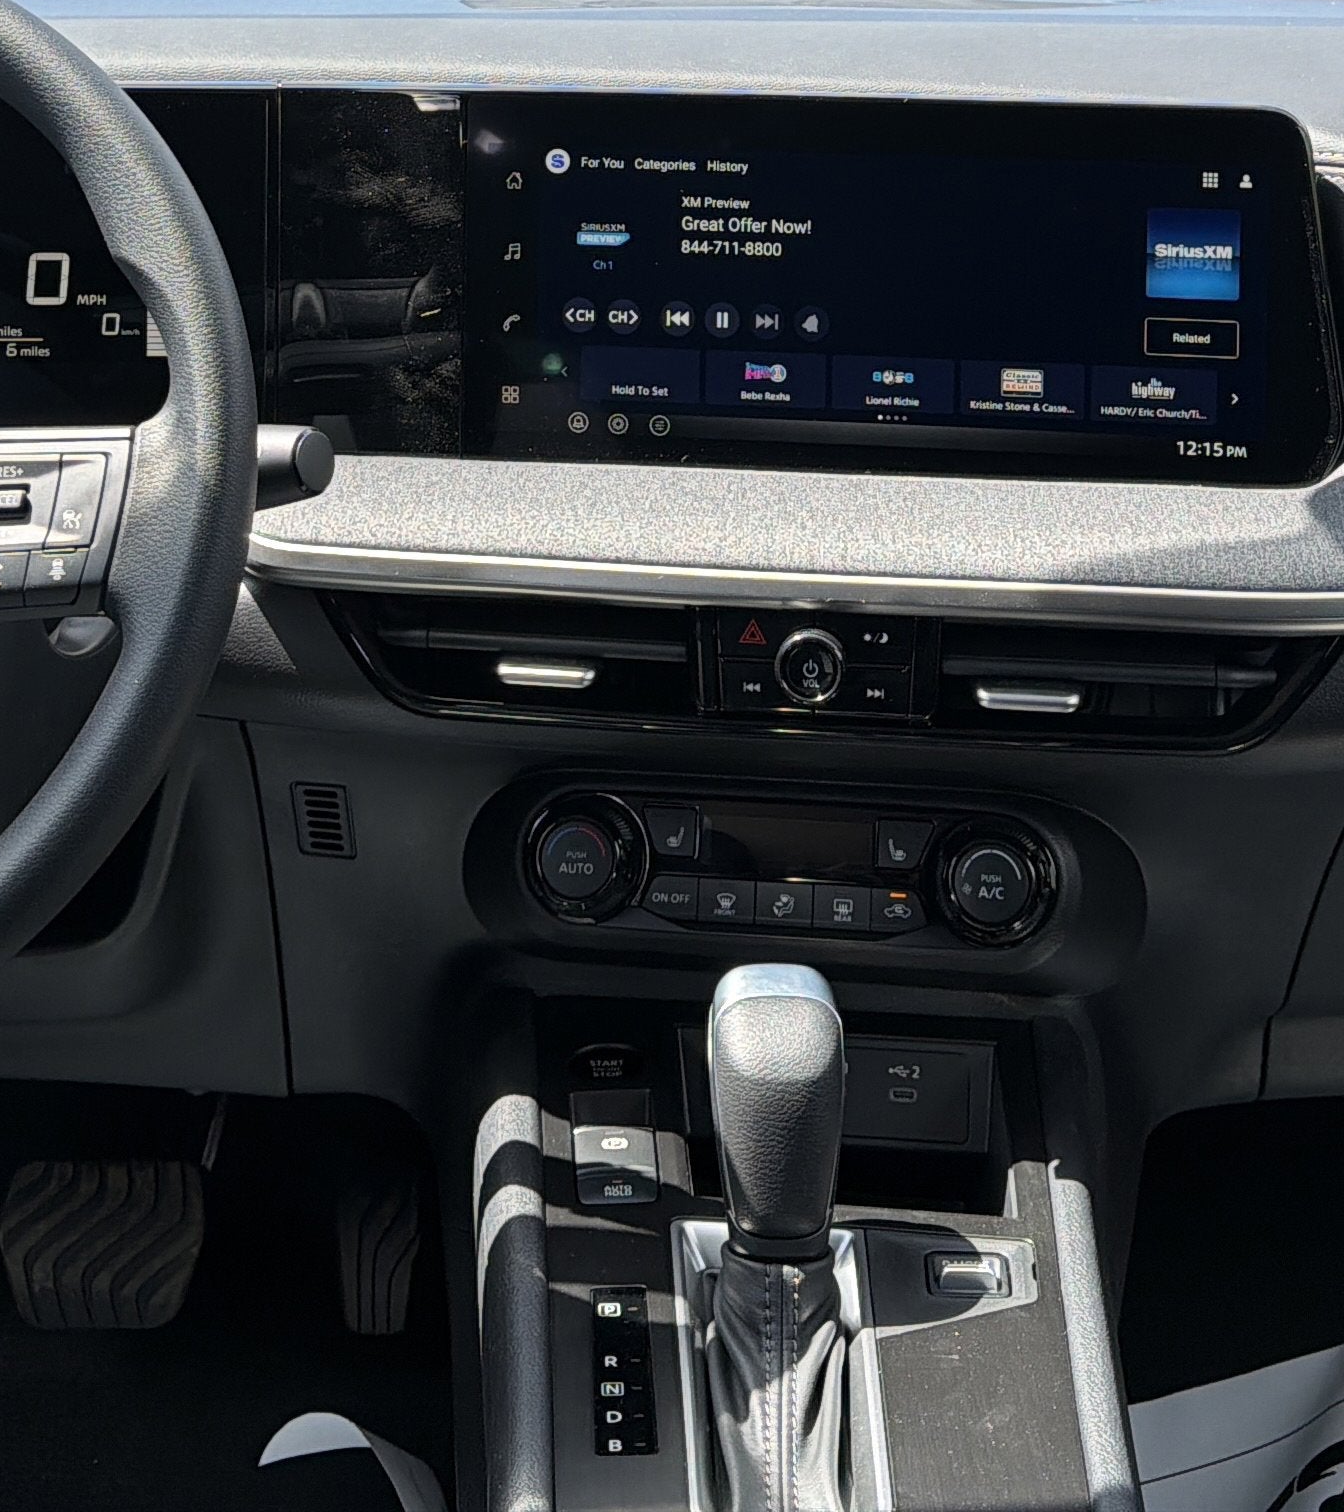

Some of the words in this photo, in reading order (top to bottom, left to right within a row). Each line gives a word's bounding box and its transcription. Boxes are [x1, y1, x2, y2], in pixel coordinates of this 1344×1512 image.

[580, 157, 601, 169] For
[602, 157, 625, 169] You
[634, 158, 696, 172] Categories
[707, 160, 749, 175] History
[681, 196, 701, 208] XM
[704, 197, 750, 210] Preview
[681, 216, 724, 232] Great
[727, 217, 768, 233] Offer
[771, 219, 812, 235] Now!
[580, 233, 624, 244] PREVIEW
[680, 239, 783, 257] 844-711-8800
[1154, 243, 1233, 259] SiriusXM
[593, 260, 607, 271] Ch
[25, 252, 70, 306] 0
[76, 294, 107, 306] MPH
[1172, 333, 1211, 344] Related
[6, 343, 17, 357] 6
[20, 345, 51, 357] miles
[611, 384, 635, 396] Hold
[637, 386, 650, 396] To
[651, 386, 669, 397] Set
[740, 391, 762, 401] Bebe
[764, 391, 791, 402] Rexha
[1131, 381, 1176, 400] highway
[865, 396, 892, 406] Lionel
[893, 396, 920, 407] Richie
[969, 400, 1003, 411] Kristine
[1005, 401, 1031, 412] Stone
[1032, 403, 1041, 412] &
[1100, 406, 1137, 417] HARDY/
[1138, 408, 1155, 417] Eric
[1176, 440, 1224, 457] 12:15
[1226, 445, 1248, 458] PM
[802, 678, 820, 688] VOL
[565, 851, 588, 859] PUSH
[558, 862, 594, 875] AUTO
[980, 873, 1002, 883] PUSH
[651, 892, 669, 903] ON
[670, 892, 691, 904] OFF
[978, 885, 1005, 900] A/C
[604, 1355, 618, 1368] R
[606, 1410, 622, 1424] D
[608, 1439, 623, 1452] B
